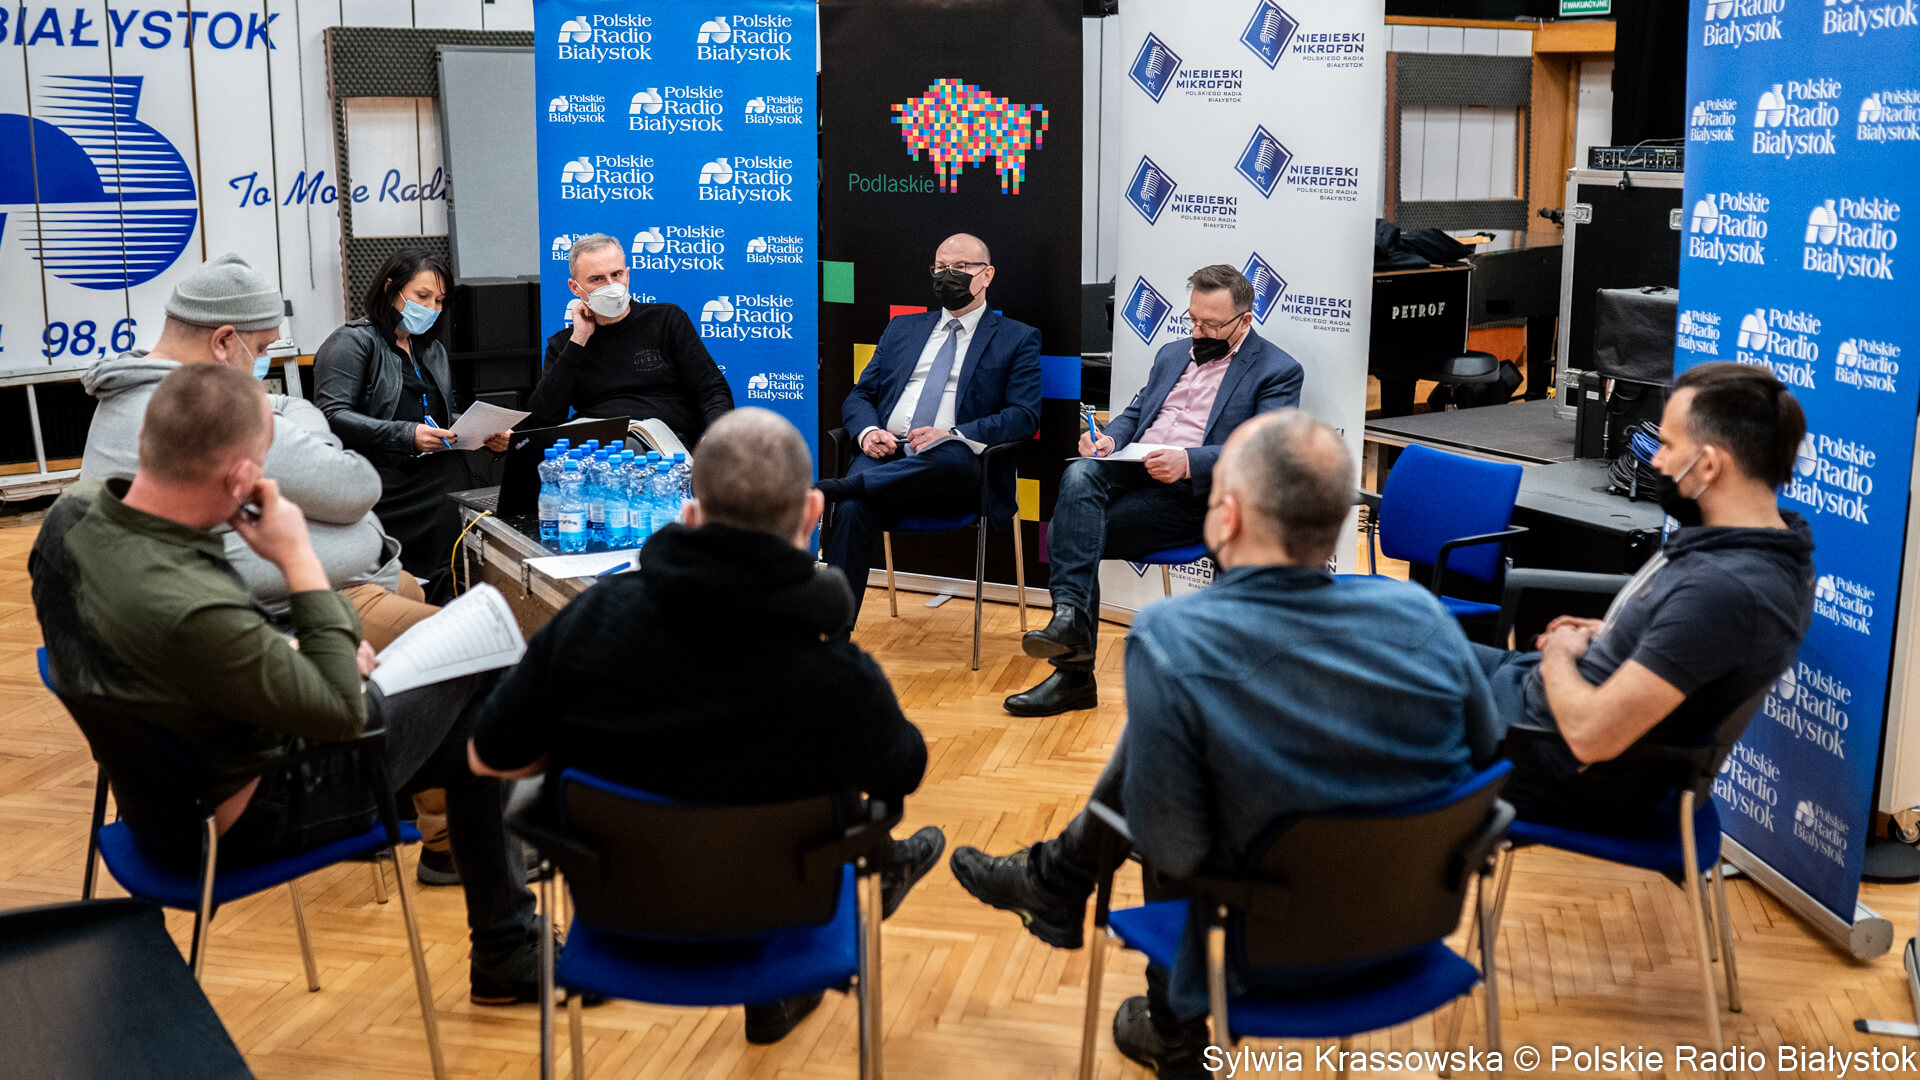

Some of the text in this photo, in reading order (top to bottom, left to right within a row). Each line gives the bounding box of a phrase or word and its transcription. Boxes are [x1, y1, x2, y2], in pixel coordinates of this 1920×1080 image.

[593, 14, 652, 27] Polskie
[732, 15, 792, 28] Polskie
[1824, 0, 1918, 36] Białystok
[593, 28, 652, 44] Radio
[732, 28, 792, 44] Radio
[1296, 32, 1365, 42] NIEBIESKI
[1704, 16, 1782, 48] Białystok
[558, 45, 652, 63] Białystok
[697, 45, 792, 64] Białystok
[1292, 44, 1364, 54] MIKROFON
[1180, 70, 1242, 78] NIEBIESKI
[664, 86, 723, 98] Polskie
[1176, 80, 1242, 89] MIKROFON
[1788, 78, 1842, 100] Polskie
[569, 94, 605, 102] Polskie
[766, 96, 802, 104] Polskie
[1706, 98, 1737, 110] Polskie
[569, 103, 605, 112] Radio
[664, 100, 723, 115] Radio
[766, 104, 802, 114] Radio
[1785, 102, 1839, 127] Radio
[1880, 105, 1920, 122] Radio
[548, 113, 605, 124] Białystok
[629, 116, 723, 134] Białystok
[745, 114, 802, 126] Białystok
[1705, 112, 1736, 126] Radio
[1690, 127, 1734, 144] Białystok
[1857, 124, 1920, 144] Białystok
[1752, 129, 1836, 160] Białystok
[596, 155, 654, 168] Polskie
[734, 156, 792, 169] Polskie
[596, 168, 654, 184] Radio
[734, 170, 792, 185] Radio
[1290, 165, 1358, 176] NIEBIESKI
[849, 173, 934, 193] Podlaskie
[1287, 176, 1358, 187] MIKROFON
[229, 166, 446, 217] To Moe Rad
[561, 185, 654, 203] Białystok
[699, 186, 792, 204] Białystok
[1175, 194, 1237, 206] NIEBIESKI
[1172, 204, 1236, 215] MIKROFON
[1720, 192, 1770, 213] Polskie
[1840, 197, 1900, 222] Polskie
[666, 226, 724, 238] Polskie
[1718, 214, 1768, 238] Radio
[767, 236, 803, 244] Polskie
[1837, 222, 1898, 250] Radio
[666, 239, 724, 254] Radio
[767, 244, 803, 254] Radio
[1689, 237, 1765, 266] Białystok
[632, 255, 724, 273] Białystok
[747, 254, 803, 265] Białystok
[1802, 246, 1894, 280] Białystok
[736, 294, 793, 308] Polskie
[1284, 294, 1352, 308] NIEBIESKI
[736, 308, 793, 323] Radio
[1282, 304, 1351, 318] MIKROFON
[1392, 302, 1445, 320] PETROF
[1692, 310, 1721, 326] Polskie
[1291, 316, 1328, 324] POLSKIEGO
[1769, 308, 1822, 335] Polskie
[42, 318, 137, 358] 98,6
[700, 324, 793, 342] Białystok
[1690, 323, 1720, 340] Radio
[1678, 334, 1718, 355] Białystok
[1767, 331, 1818, 362] Radio
[1858, 338, 1901, 358] Polskie
[1856, 354, 1899, 376] Radio
[768, 372, 804, 381] Polskie
[1835, 366, 1896, 392] Białystok
[768, 381, 804, 390] Radio
[748, 390, 804, 401] Białystok
[1818, 434, 1876, 468] Polskie
[1816, 458, 1873, 496] Radio
[1782, 478, 1869, 524] Białystok
[1168, 564, 1210, 578] KROFO
[1836, 576, 1875, 601] Polskie
[1835, 590, 1873, 618] Radio
[1814, 600, 1870, 635] Białystok
[1798, 661, 1852, 705] Polskie
[1796, 684, 1848, 732] Radio
[1764, 694, 1845, 760] Białystok
[1732, 740, 1780, 782] Polskie
[1730, 757, 1778, 807] Radio
[1713, 778, 1774, 832] iałystok
[1815, 804, 1849, 834] Polskie
[1814, 819, 1847, 851] Radio
[1794, 821, 1845, 868] Białystok
